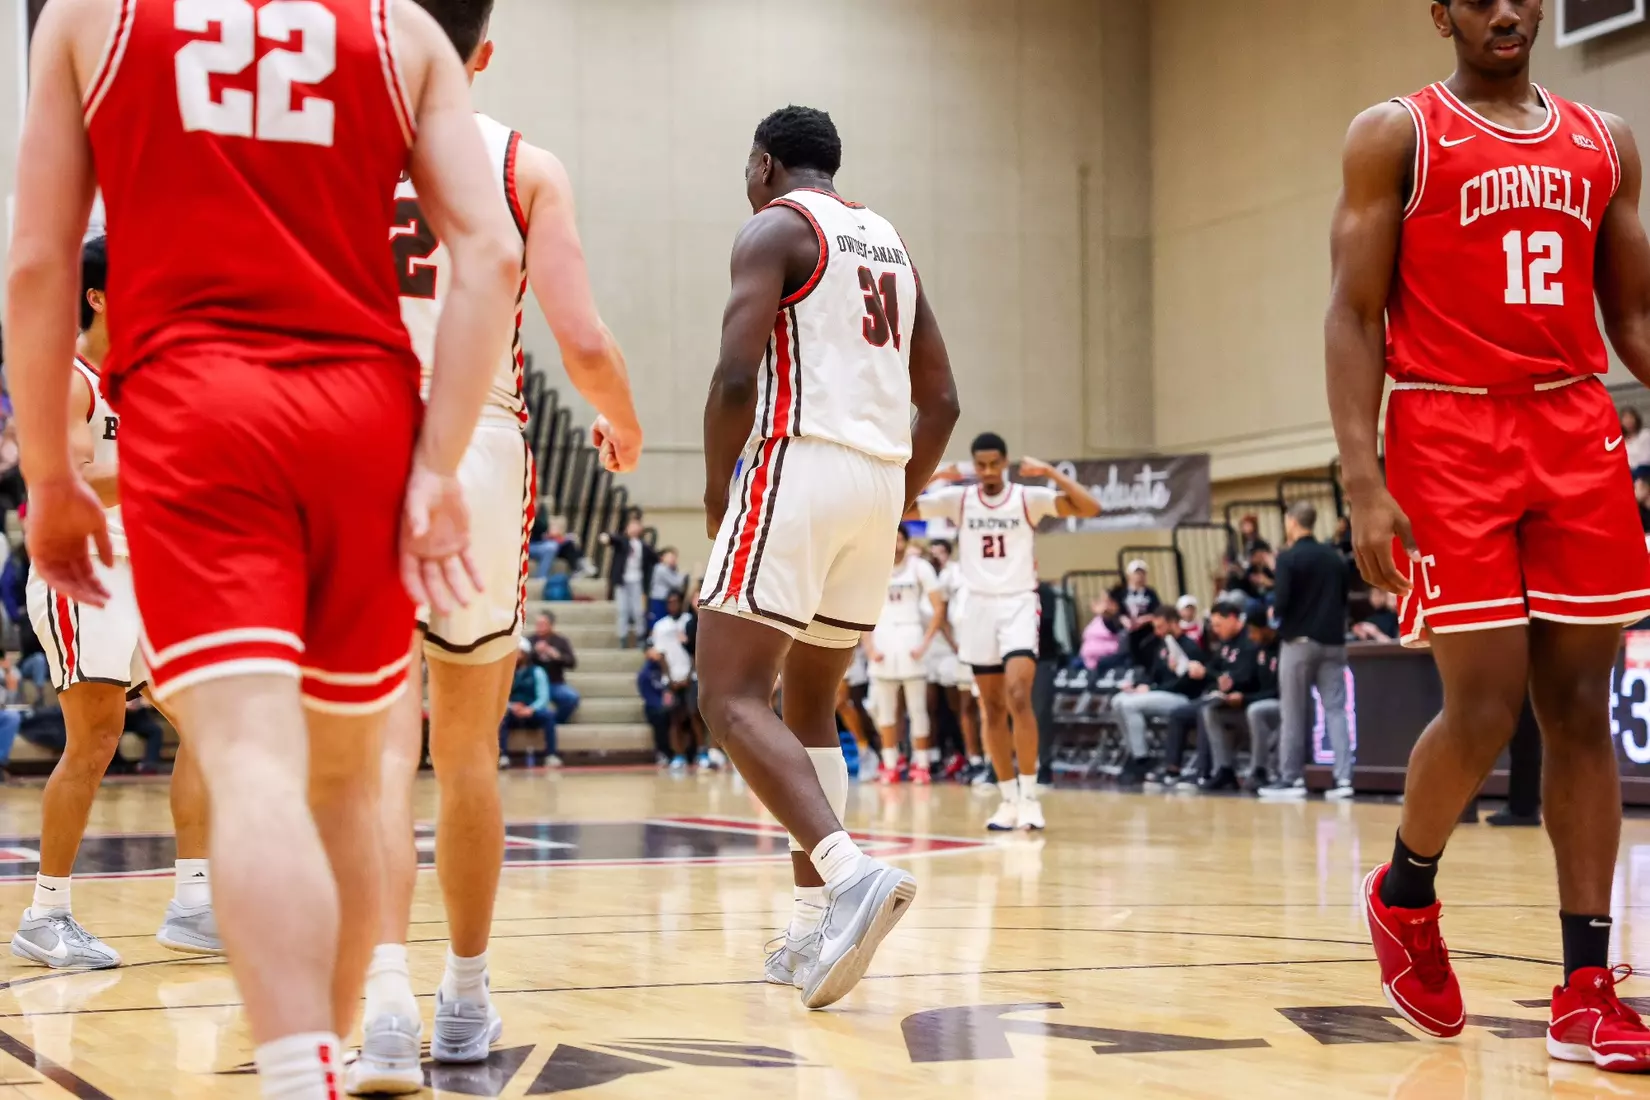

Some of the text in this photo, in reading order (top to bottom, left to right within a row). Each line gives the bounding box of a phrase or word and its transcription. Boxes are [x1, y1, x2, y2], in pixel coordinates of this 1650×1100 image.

[174, 0, 336, 147] 22
[1460, 165, 1592, 232] CORNELL
[1502, 230, 1564, 306] 12
[857, 265, 900, 352] 31
[982, 535, 1006, 558] 21
[1421, 554, 1441, 600] C
